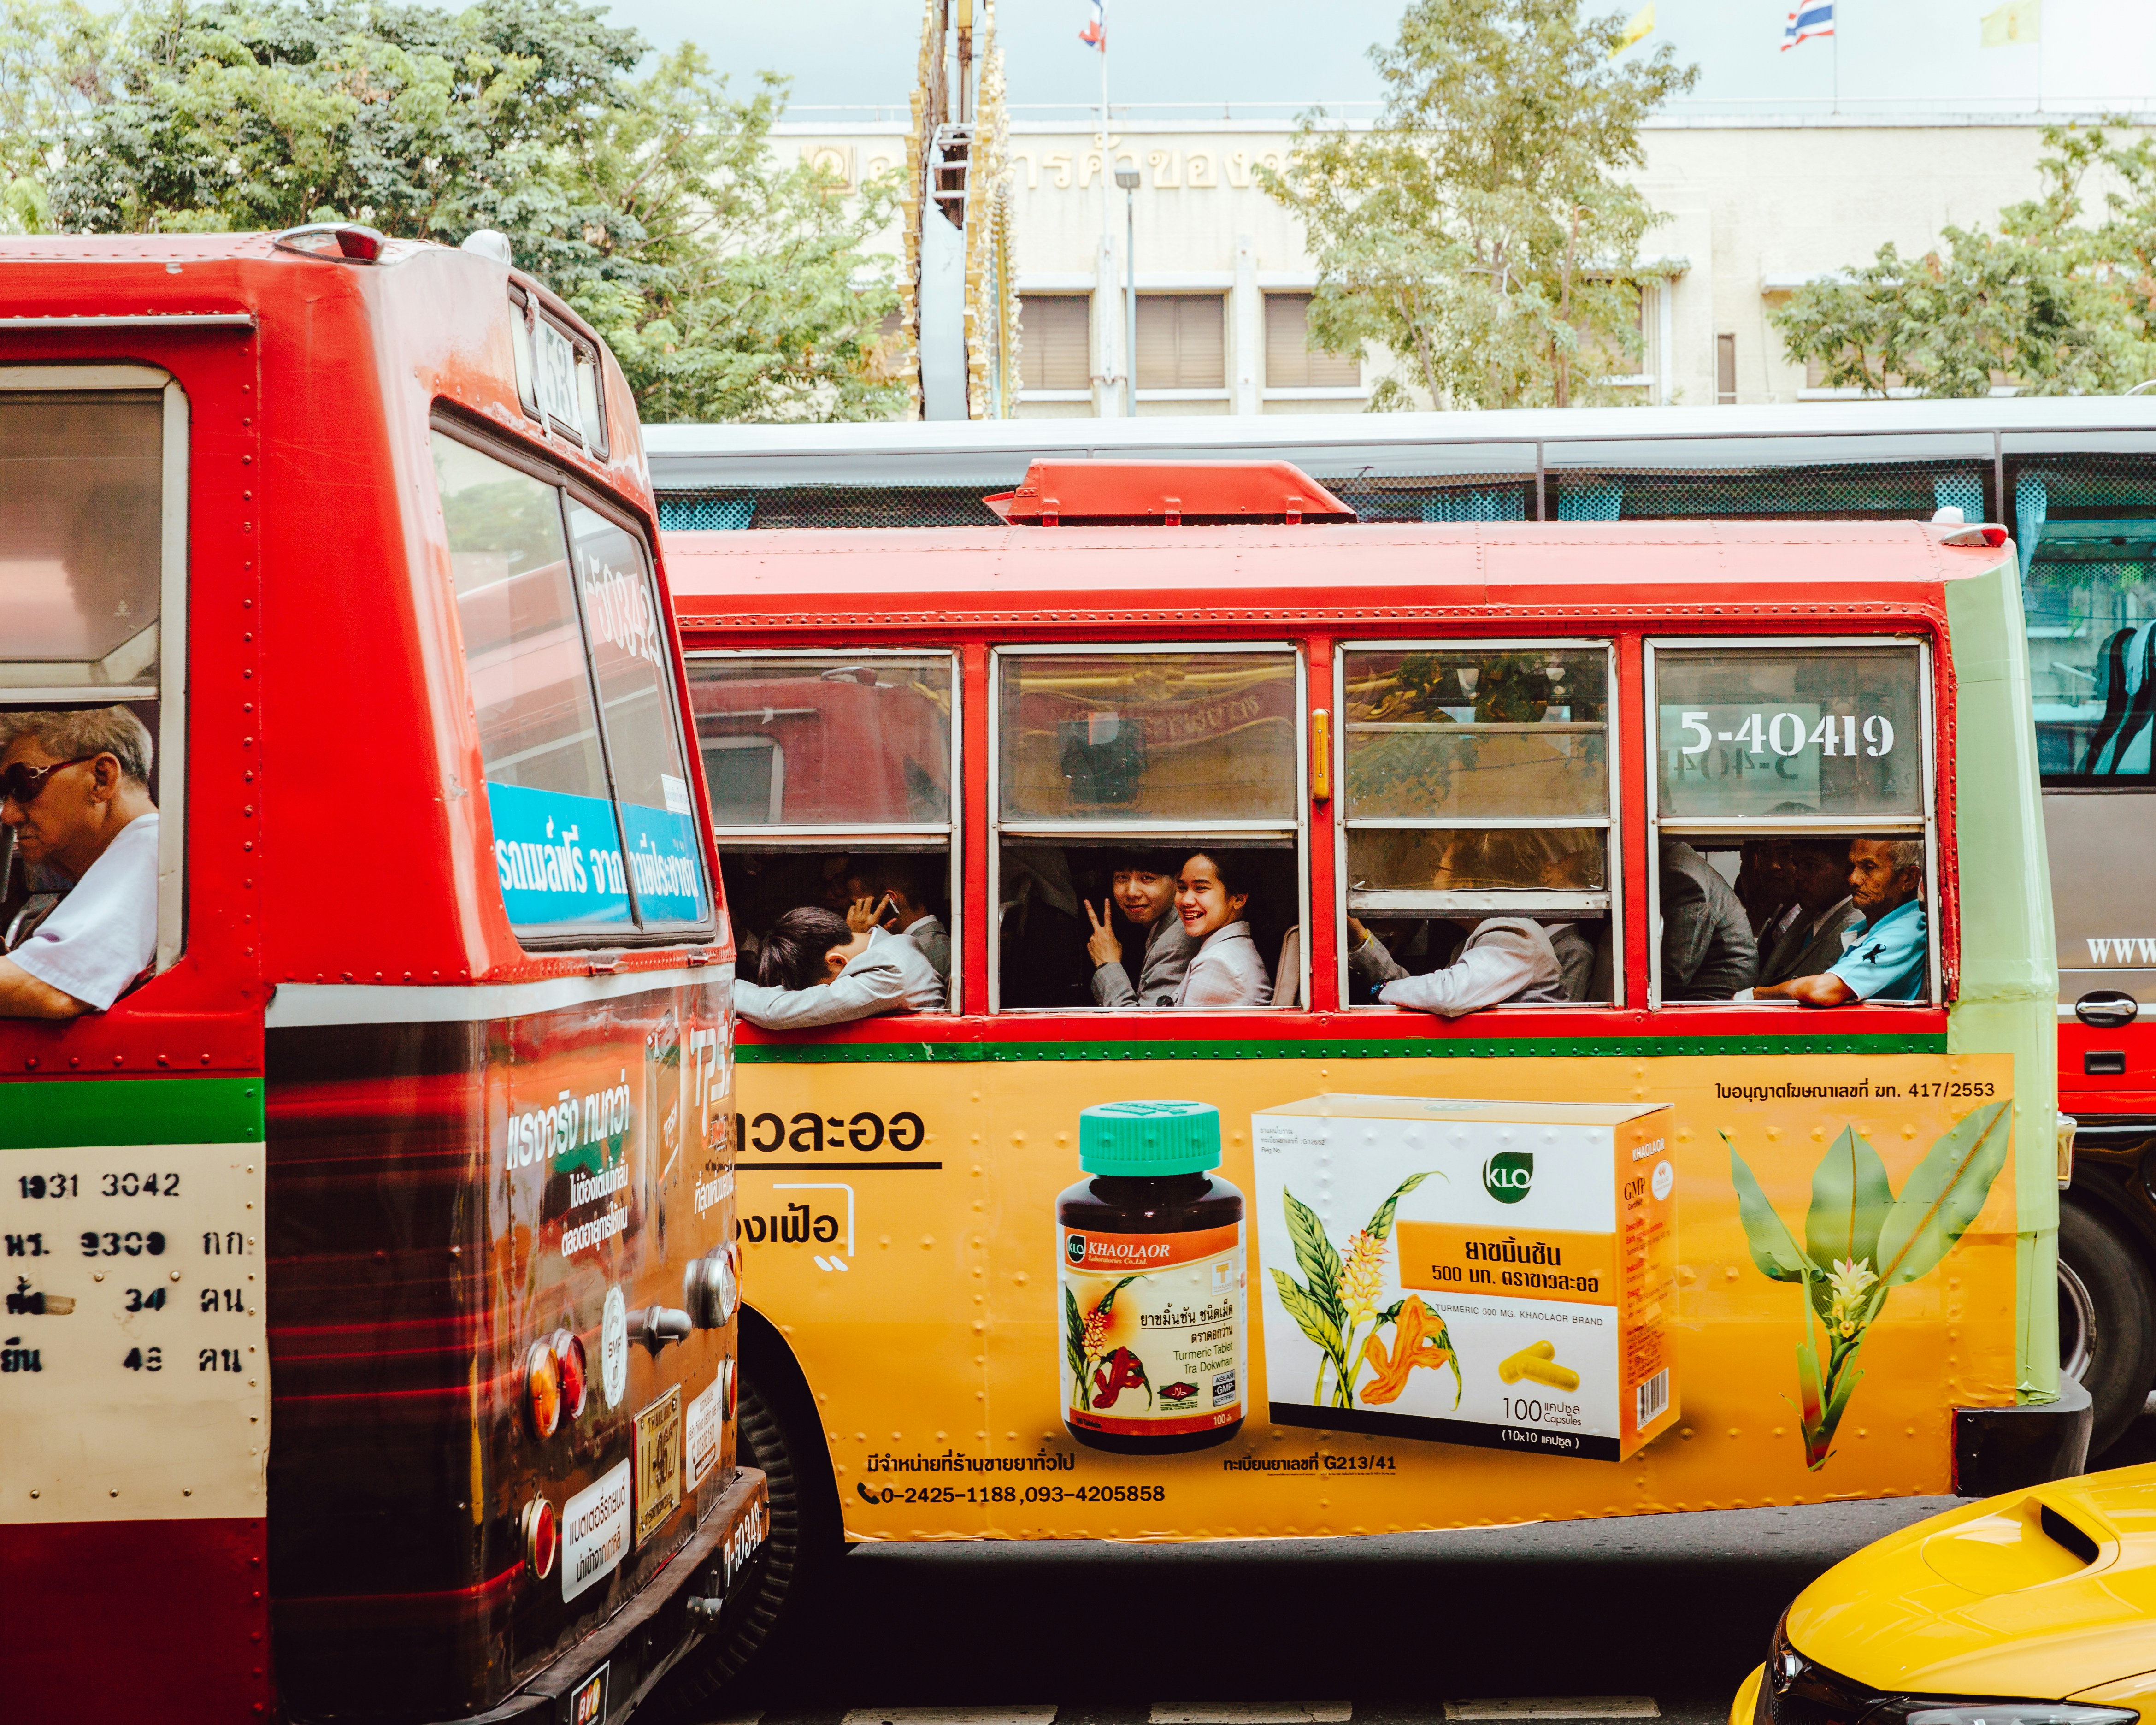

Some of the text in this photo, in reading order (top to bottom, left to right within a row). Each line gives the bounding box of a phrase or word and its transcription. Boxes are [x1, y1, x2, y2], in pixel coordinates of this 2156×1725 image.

[576, 546, 660, 667] 7-50342
[1681, 712, 1895, 756] 5-40419
[495, 815, 587, 893] รถเมล์ฟรี
[590, 848, 628, 894] จาก
[1715, 1078, 1995, 1102] ใบอนุญาตโฆษณาเลขที่ ฆท. 417/2553
[506, 1068, 630, 1170] แรงจริง ทนกว่า
[1632, 1137, 1665, 1163] KHAOLAOR
[102, 1173, 180, 1197] 3042
[570, 1151, 628, 1209] ไม่ต้องเติมน้ำกลั่น
[1485, 1162, 1532, 1189] KLO
[1624, 1178, 1645, 1201] GMP
[561, 1201, 628, 1257] ตลอดอายุการใช้งาน
[736, 1202, 839, 1243] งเฟ้อ
[1069, 1242, 1170, 1258] KLO KHAOLAOR
[1088, 1256, 1122, 1264] Laboratories
[1465, 1236, 1561, 1266] ยาขมิ้นชัน
[1432, 1265, 1599, 1293] 500 มก. ตราขาวละออ
[201, 1287, 245, 1313] คน
[1141, 1298, 1233, 1326] ยาขมิ้นชัน ชนิดเม็ด
[1436, 1304, 1603, 1326] TURMERIC 500 MG. KHAOLAOR BRAND
[1191, 1323, 1233, 1343] ตราดอกว่าน
[608, 1335, 621, 1359] SMF
[1173, 1341, 1233, 1360] Turmeric Tablet
[199, 1347, 243, 1374] คน
[1183, 1357, 1233, 1374] Tra Dokwhan
[1215, 1373, 1234, 1383] ASEAN
[1217, 1382, 1233, 1394] GMP
[1215, 1393, 1234, 1404] CERTIFIED
[1503, 1397, 1542, 1422] 100
[1544, 1402, 1580, 1416] แคปซูล
[1213, 1413, 1226, 1425] 100
[1544, 1412, 1582, 1426] Capsules
[1541, 1435, 1572, 1449] แคปซูล
[867, 1448, 1075, 1472] มีจำหน่ายที่ร้านขายยาทั่วไป
[1224, 1452, 1396, 1471] ทะเบียนยาเลขที่ G213/41
[570, 1476, 625, 1546] แบตเตอรี่รถยนต์
[577, 1523, 621, 1583] นำเข้าจากเกาหลี
[724, 1501, 762, 1587] 7-50342
